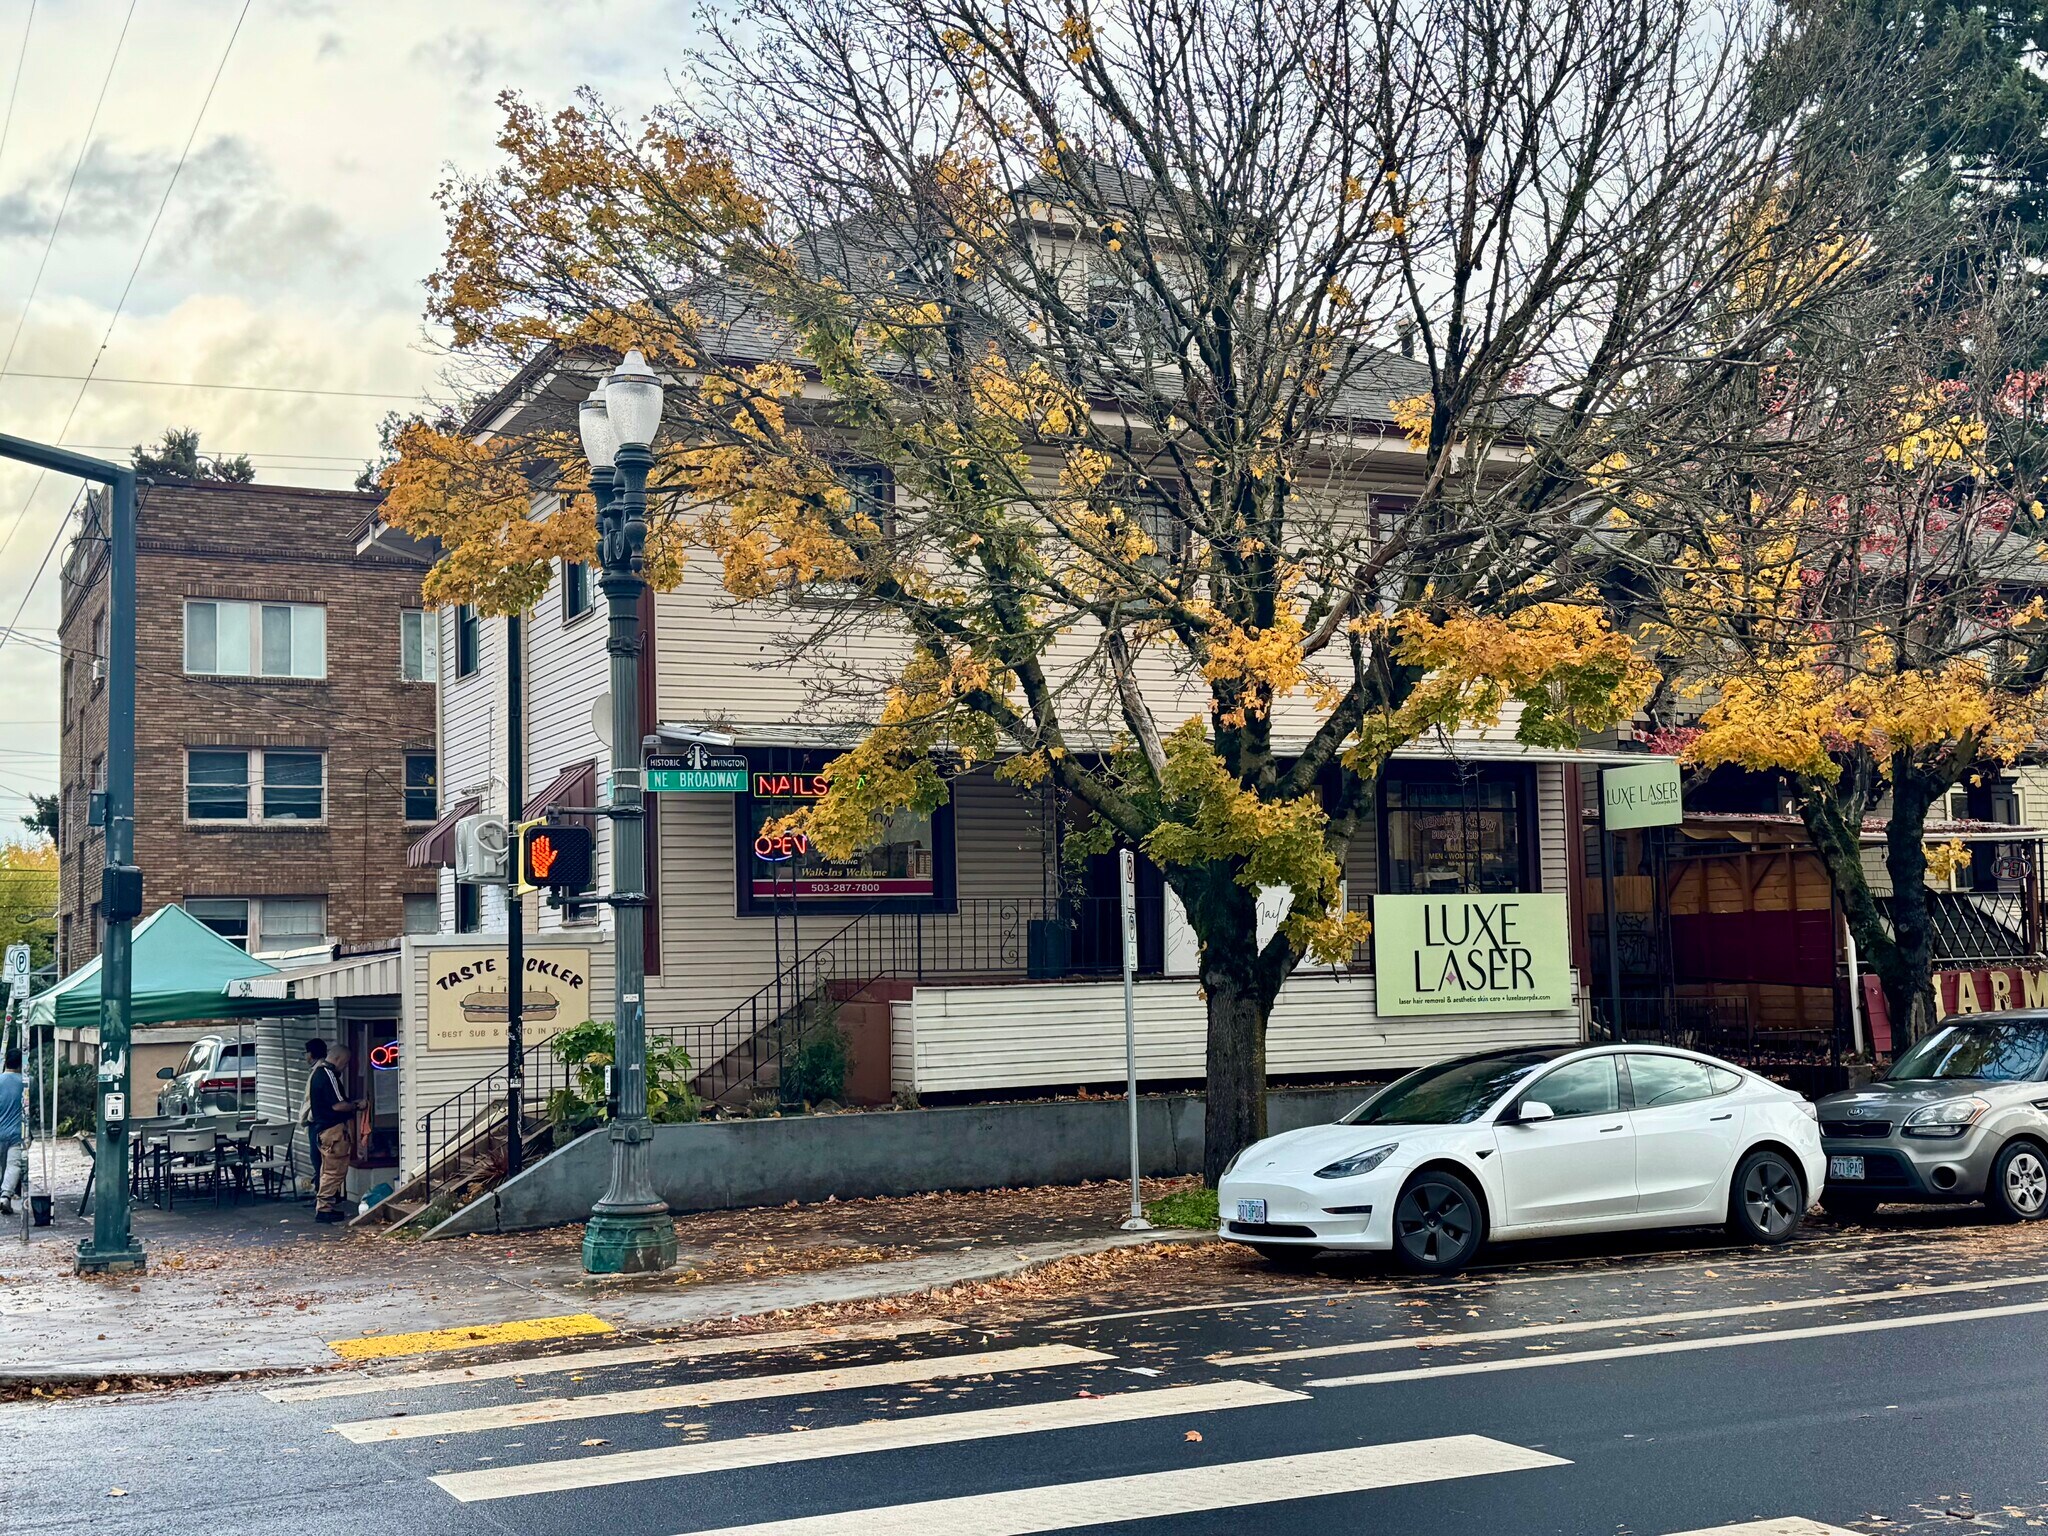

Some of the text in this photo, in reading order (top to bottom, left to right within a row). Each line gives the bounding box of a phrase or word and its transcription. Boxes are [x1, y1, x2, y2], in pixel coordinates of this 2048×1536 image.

[650, 759, 745, 767] HISTORIC IRVINGTON
[654, 772, 739, 787] NE BROADWAY
[759, 776, 827, 795] NAILS
[1606, 782, 1678, 810] LUXE LASER
[1785, 800, 1792, 814] 1
[801, 868, 887, 877] Walk-Ins Welcome
[811, 883, 880, 892] 503-287-7800
[1424, 904, 1521, 963] LUXE
[436, 957, 584, 990] TASTE CKLER
[1415, 949, 1535, 992] LASER
[1478, 994, 1488, 1002] skin
[442, 1030, 462, 1038] BEST
[469, 1029, 486, 1037] SUB
[538, 1027, 546, 1035] IN
[371, 1046, 398, 1064] OP
